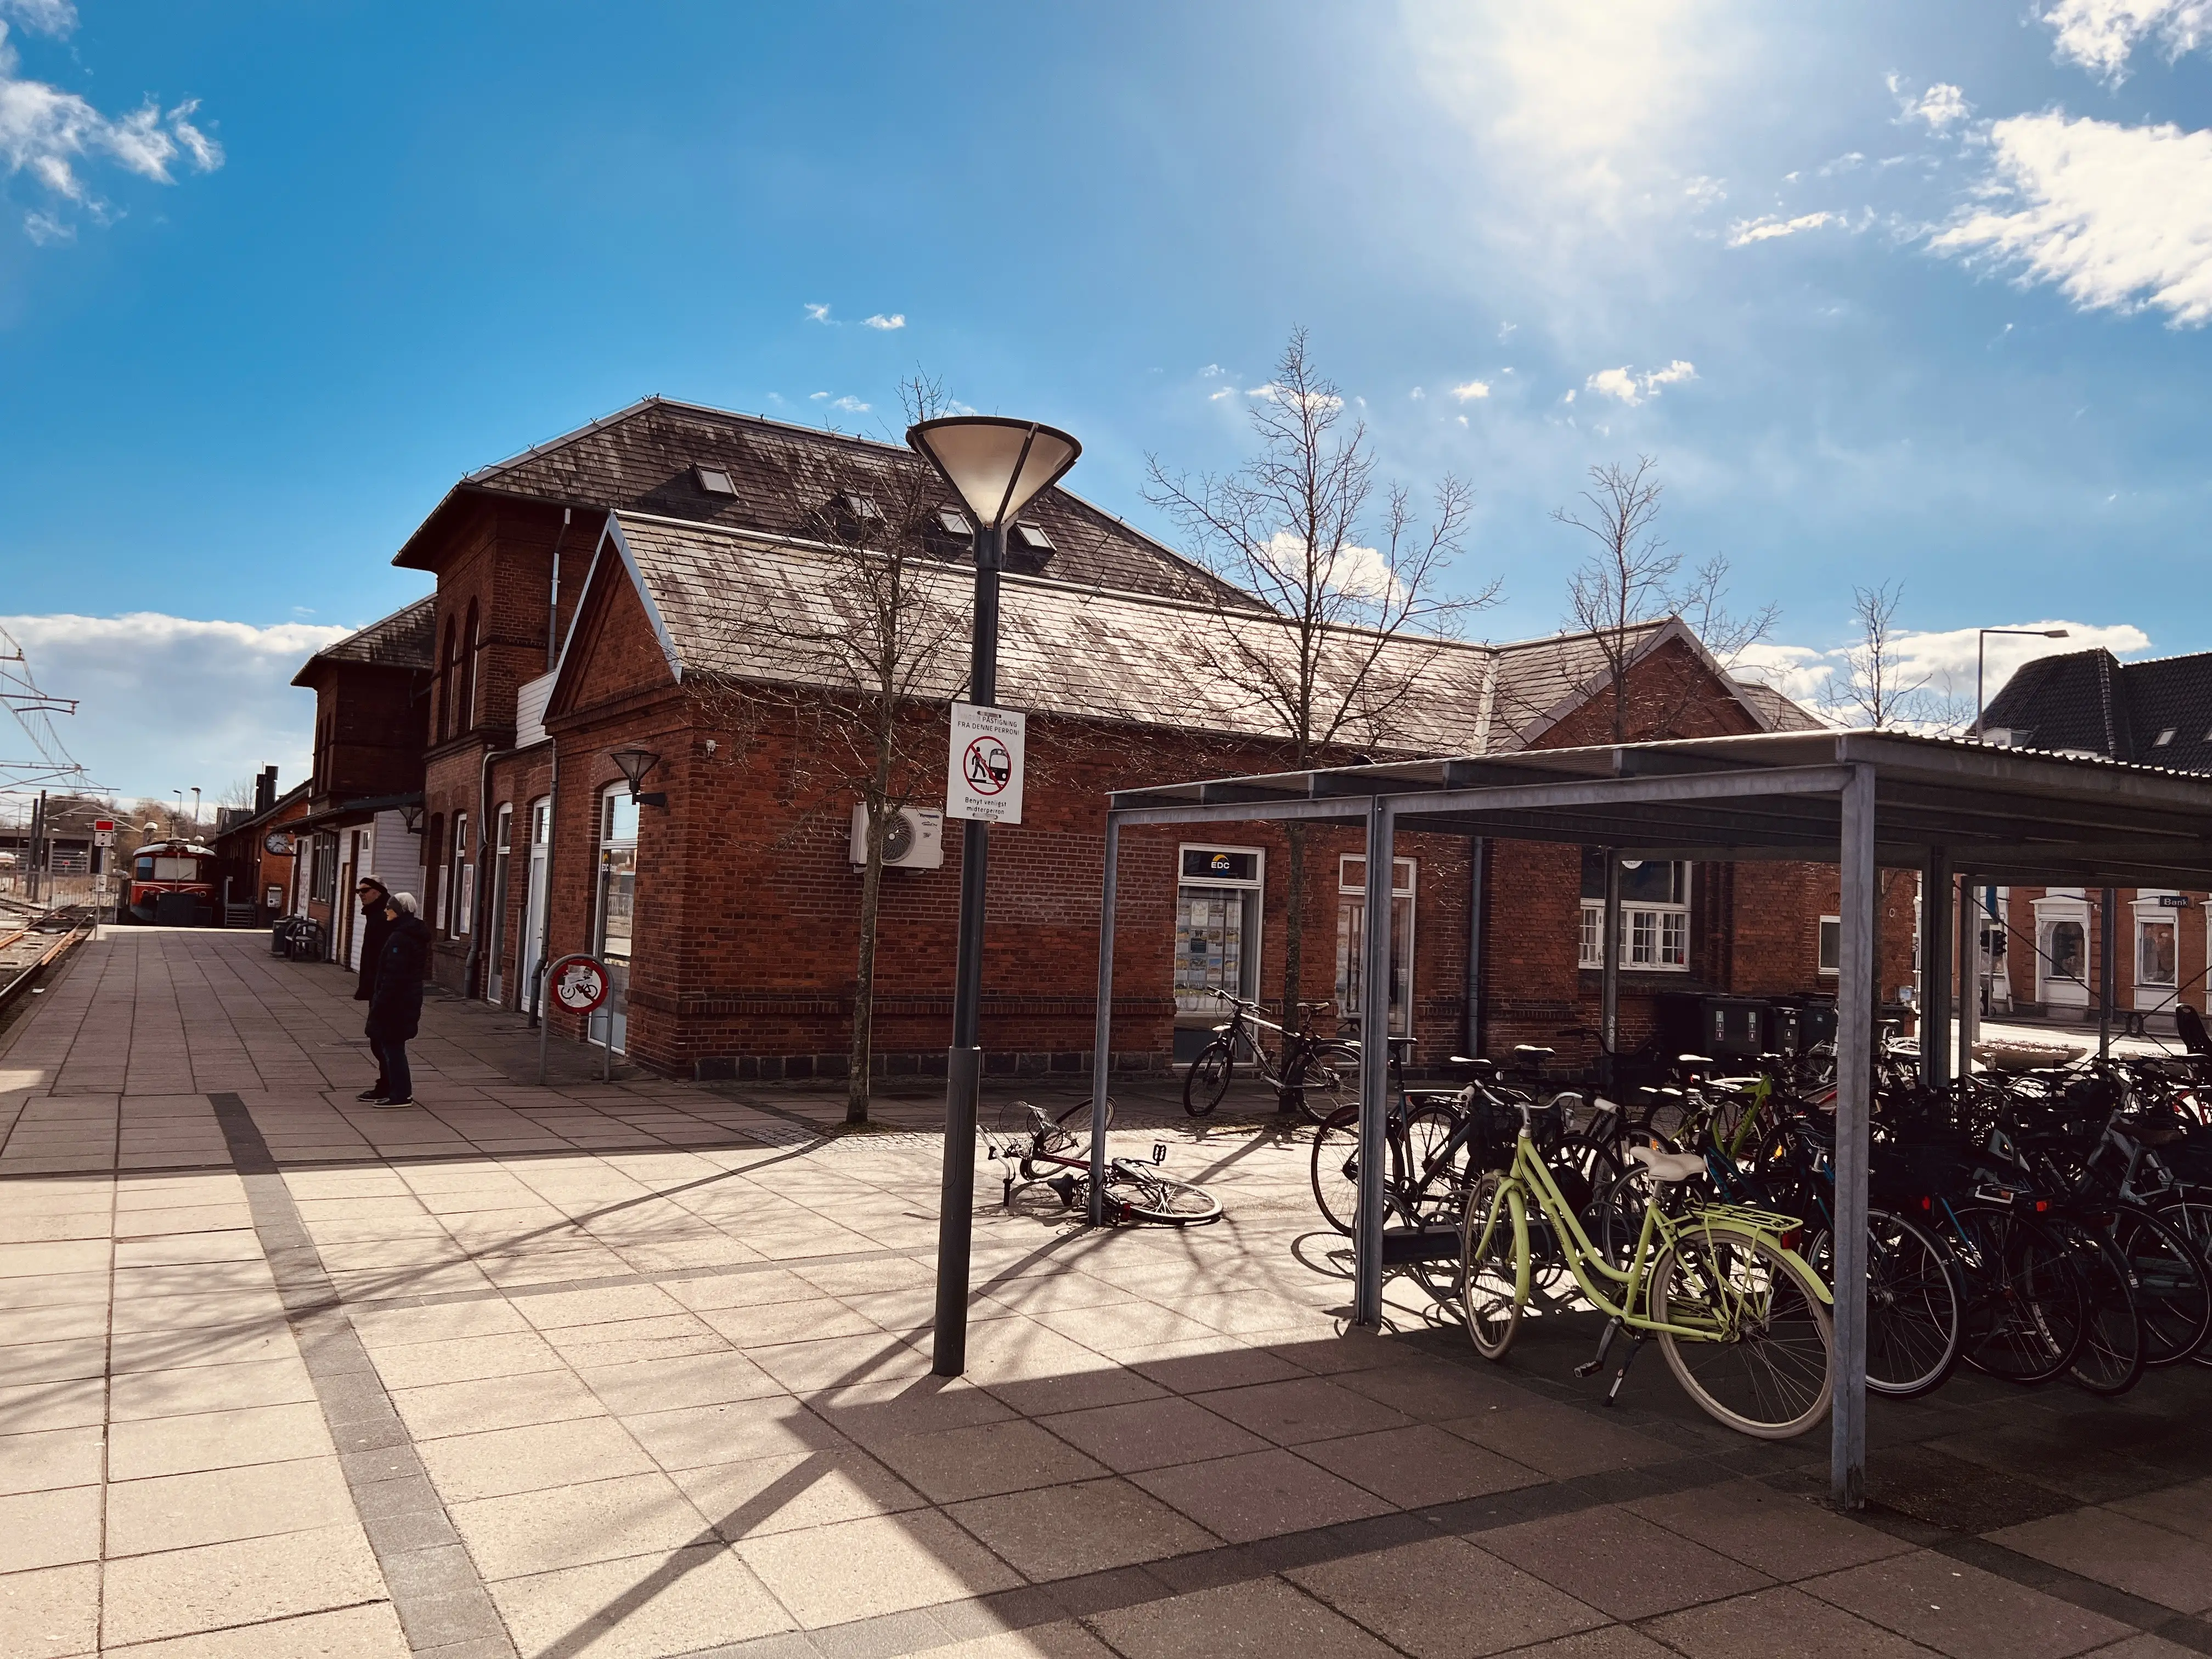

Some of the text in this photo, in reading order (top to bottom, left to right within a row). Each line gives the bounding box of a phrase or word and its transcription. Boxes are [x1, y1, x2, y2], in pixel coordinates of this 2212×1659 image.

[972, 723, 992, 731] DENNE
[964, 797, 983, 805] Benyt
[966, 806, 1005, 814] midterperron
[1211, 861, 1230, 870] EDC
